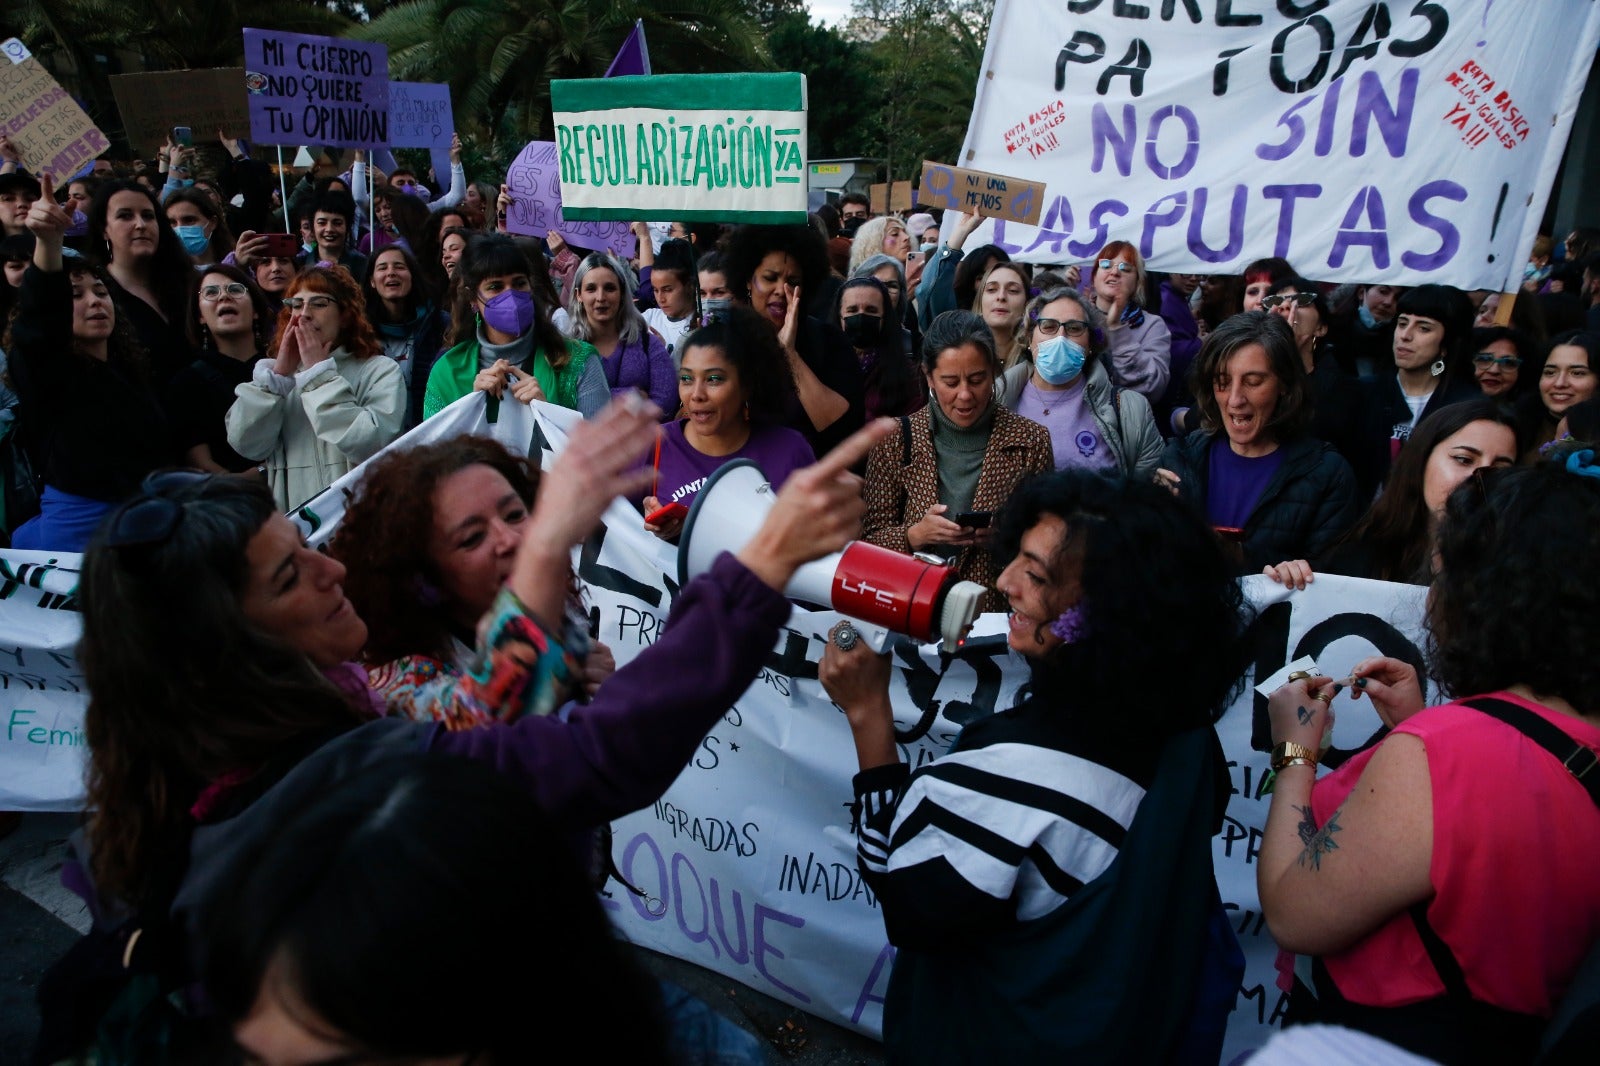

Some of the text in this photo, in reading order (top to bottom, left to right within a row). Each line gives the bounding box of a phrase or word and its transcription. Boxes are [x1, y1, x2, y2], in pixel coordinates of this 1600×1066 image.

[262, 38, 372, 77] MI CUERPO
[1055, 30, 1152, 98] PA
[268, 75, 298, 98] NO
[1460, 59, 1496, 94] RENTA
[1493, 90, 1530, 141] BASICA
[303, 103, 388, 143] OPINIÓN
[1028, 100, 1064, 125] BASICA
[1091, 67, 1421, 181] NO SIN
[1445, 72, 1517, 150] DE LAS IGUALES
[42, 127, 110, 184] MUJER
[775, 140, 802, 172] YA
[511, 165, 542, 196] ES
[966, 174, 1008, 193] NI UNA
[512, 197, 546, 229] QUE
[966, 190, 1003, 211] MENOS
[600, 831, 813, 1005] OQUE
